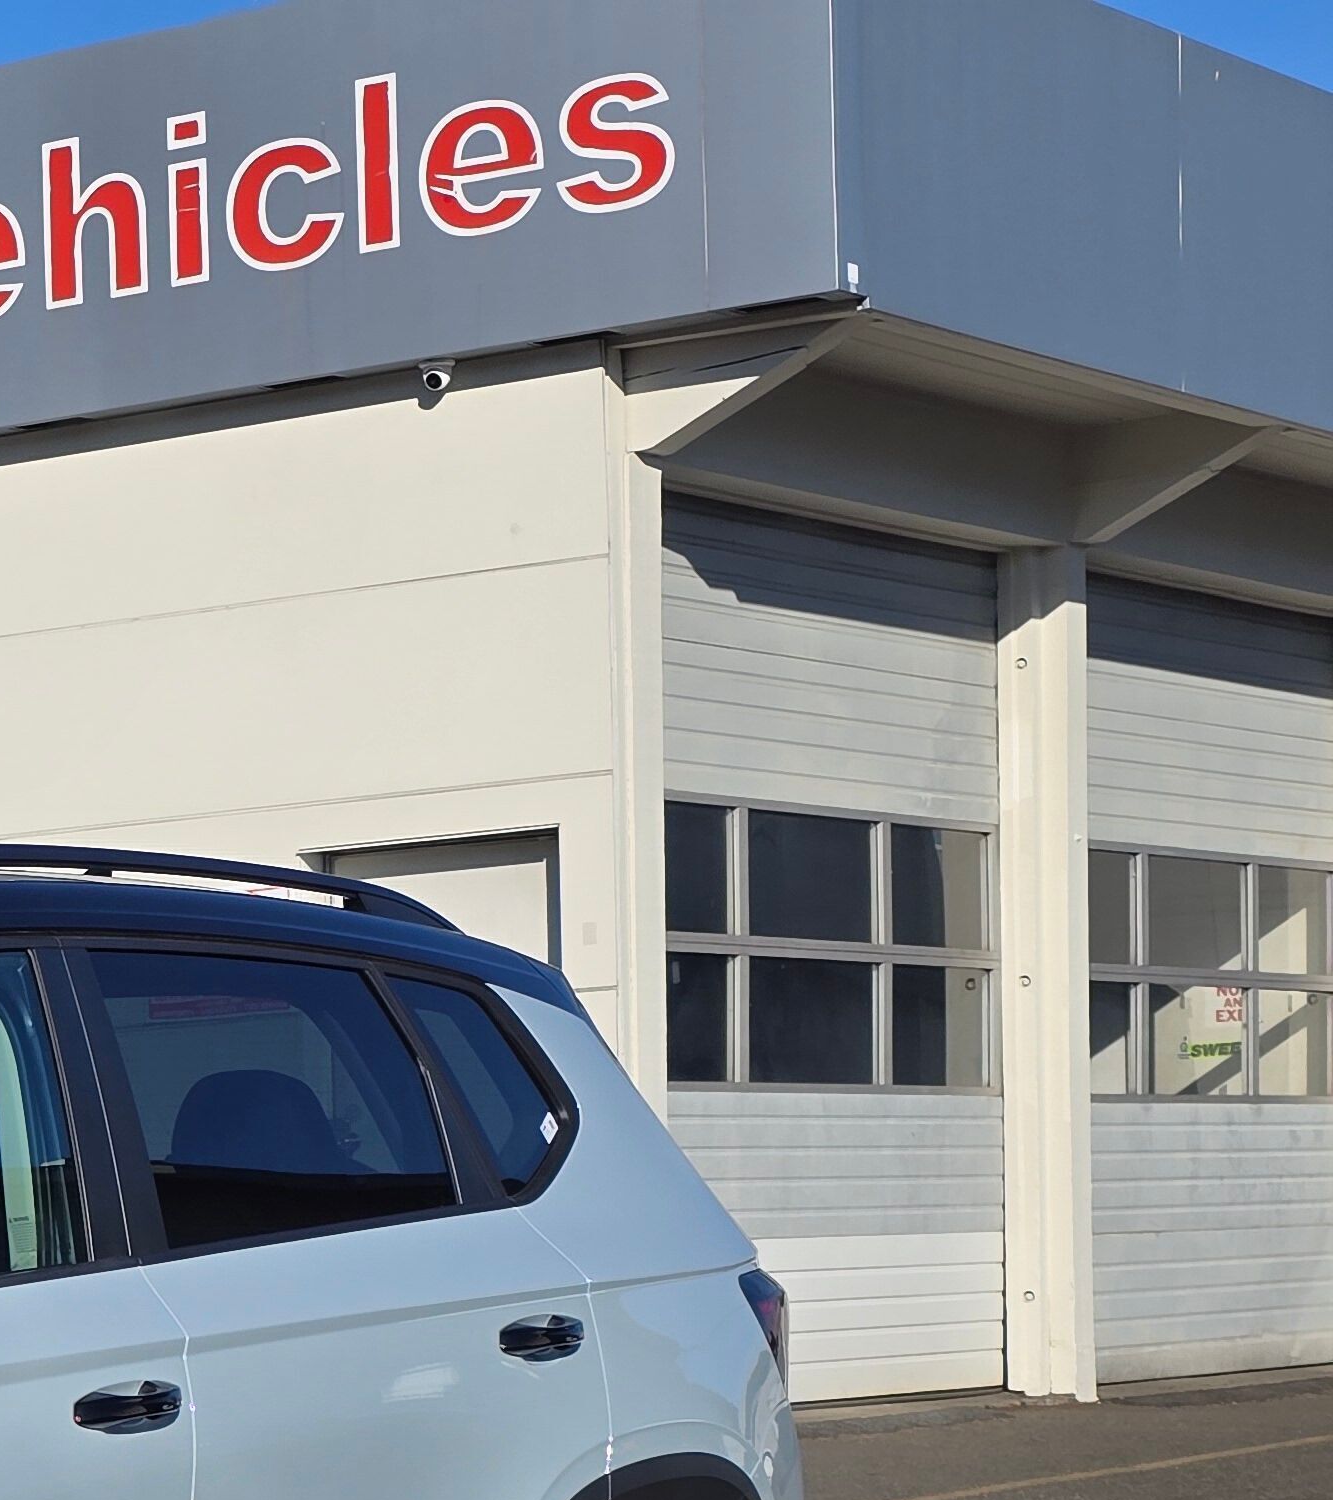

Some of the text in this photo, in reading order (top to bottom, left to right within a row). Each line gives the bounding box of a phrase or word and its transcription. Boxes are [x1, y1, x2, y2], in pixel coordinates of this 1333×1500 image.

[1216, 987, 1243, 997] NO
[1215, 1008, 1243, 1023] EXI
[1190, 1041, 1242, 1058] SWEE
